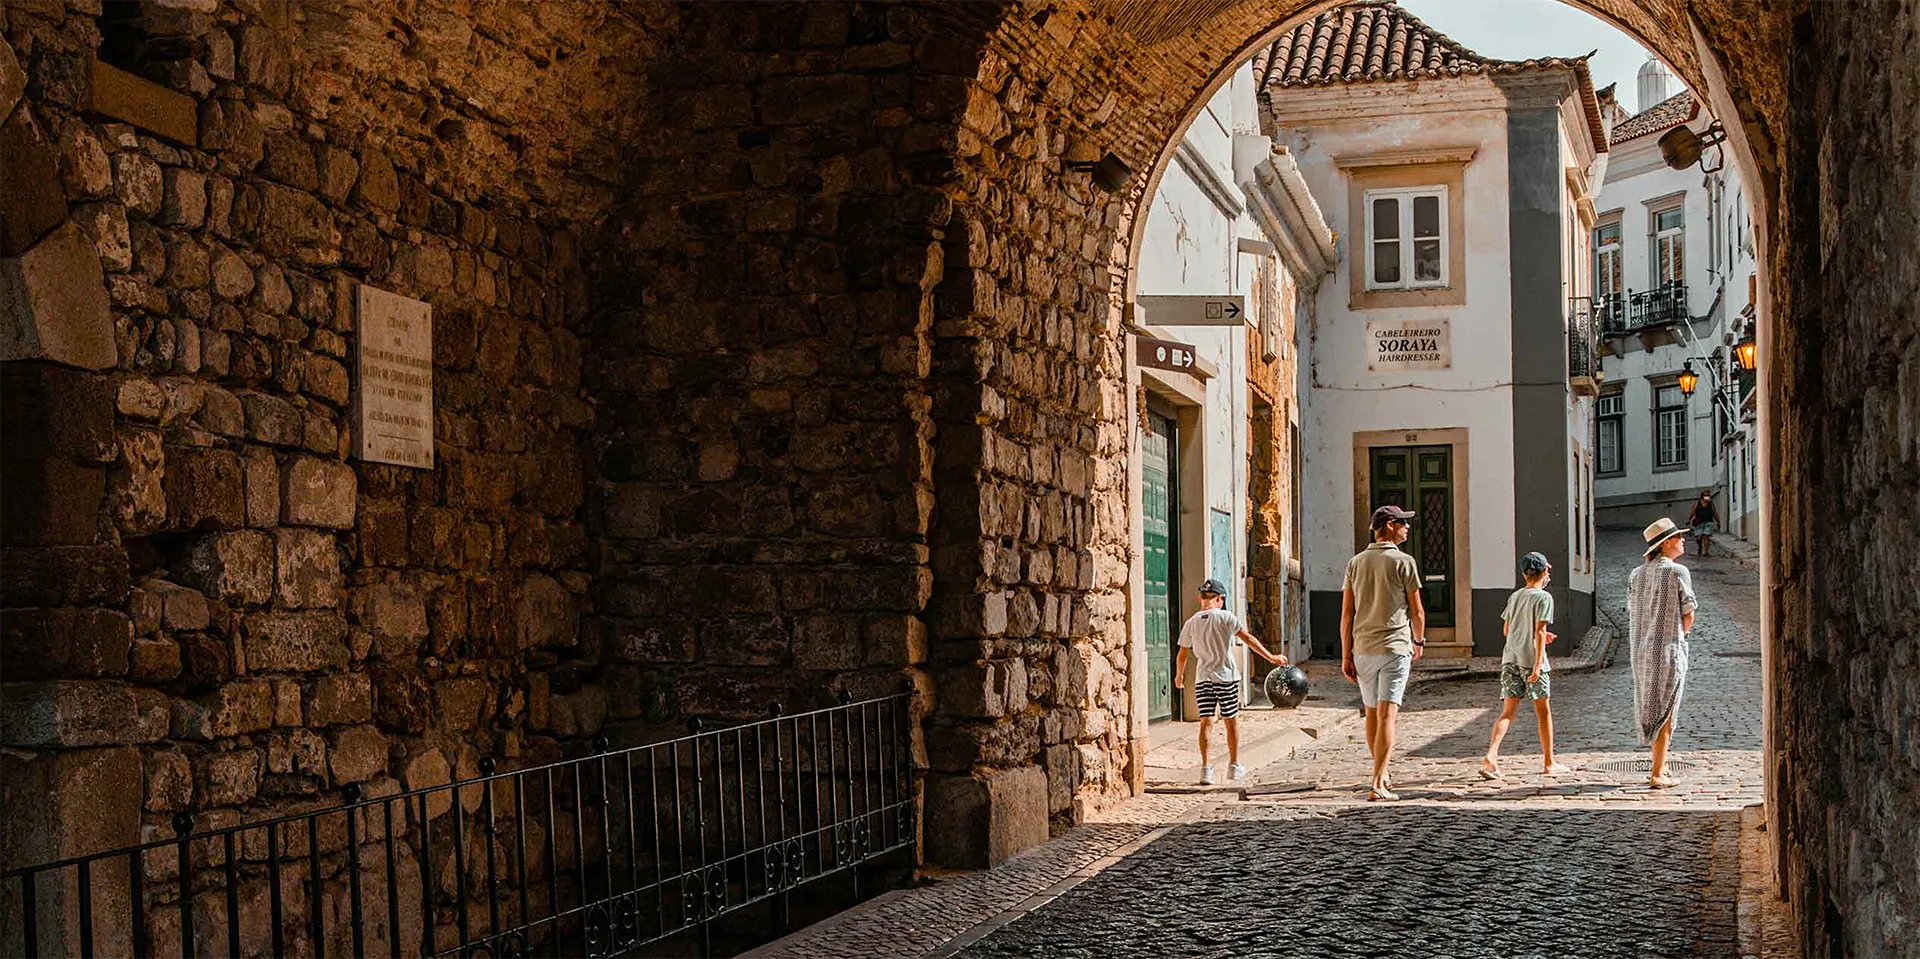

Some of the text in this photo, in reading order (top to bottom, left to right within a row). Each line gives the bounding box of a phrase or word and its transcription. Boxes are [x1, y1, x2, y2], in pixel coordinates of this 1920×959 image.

[1374, 328, 1441, 338] CABELEIREIRO
[1378, 339, 1438, 352] SORAYA
[1378, 353, 1441, 362] HAIRDRESSER
